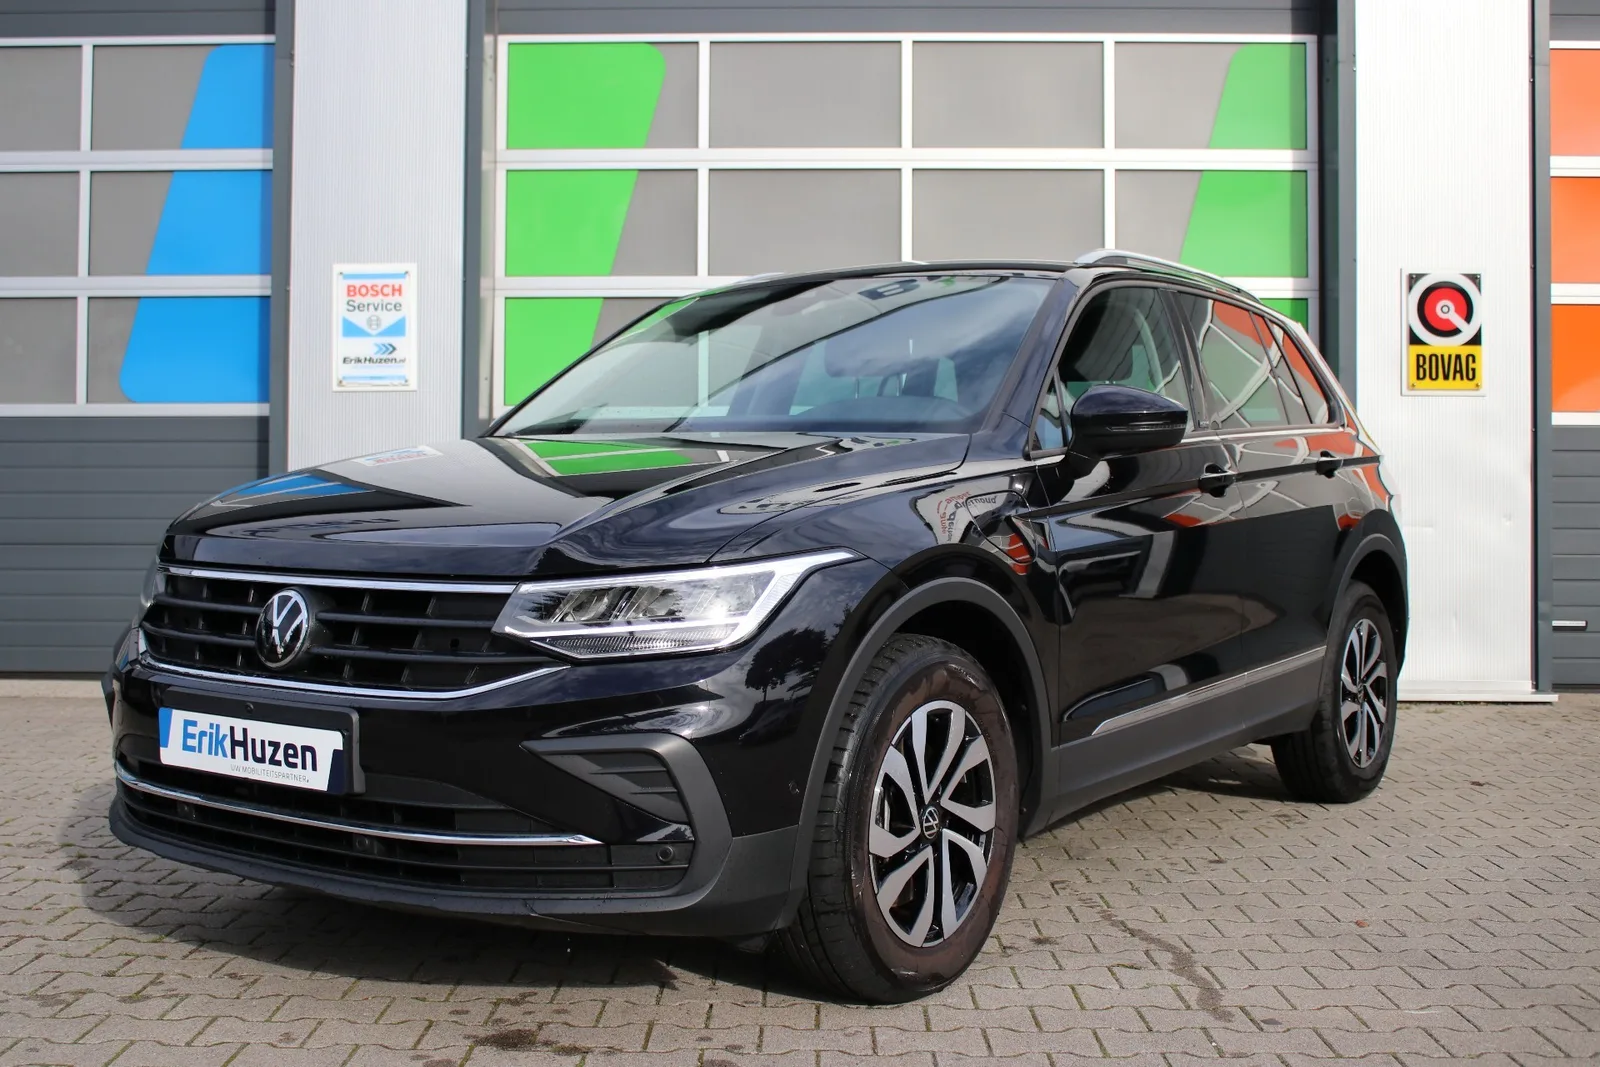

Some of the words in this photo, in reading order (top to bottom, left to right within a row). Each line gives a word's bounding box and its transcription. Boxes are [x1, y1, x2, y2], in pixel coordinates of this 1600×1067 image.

[347, 284, 402, 297] BOSCH
[346, 299, 402, 312] Service
[1416, 353, 1476, 381] BOVAG
